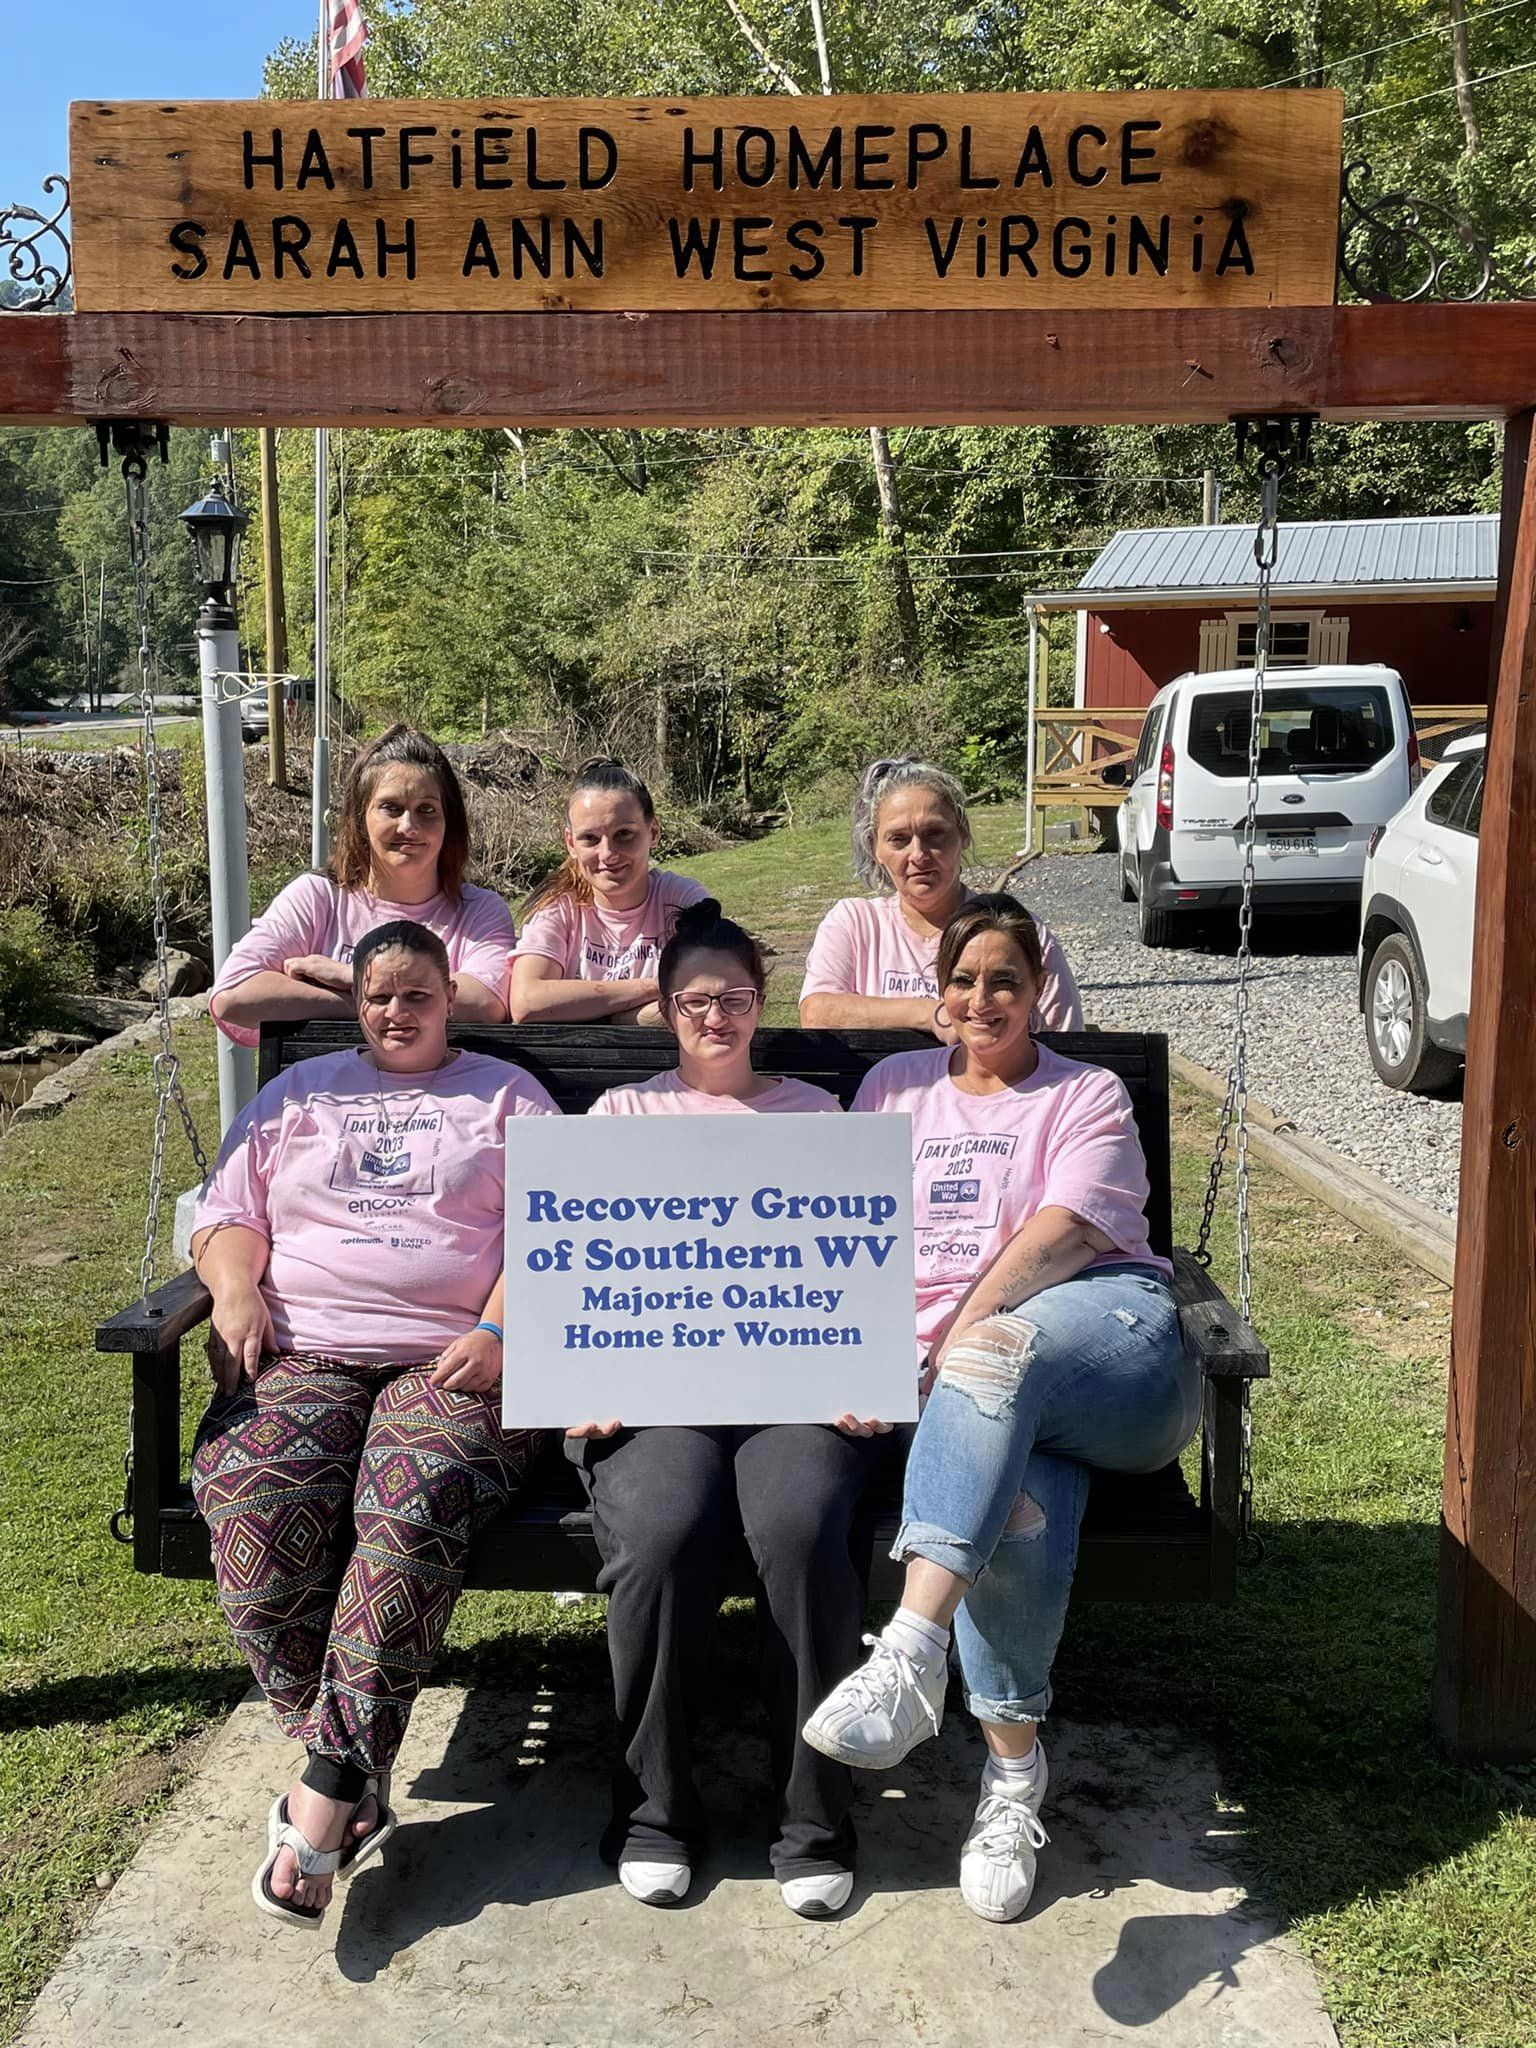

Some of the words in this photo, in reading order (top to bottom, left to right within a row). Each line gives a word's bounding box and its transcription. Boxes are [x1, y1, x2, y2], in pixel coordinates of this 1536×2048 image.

[683, 120, 1162, 191] HOMEPLACE
[169, 215, 416, 280] SARAH
[462, 216, 604, 279] ANN
[668, 217, 878, 281] WEST
[586, 945, 605, 966] DAY
[889, 977, 909, 992] DAY
[912, 977, 922, 992] OF
[351, 1118, 376, 1134] DAY
[394, 1117, 438, 1134] CARING
[924, 1144, 949, 1159] DAY
[950, 1141, 964, 1158] OF
[964, 1139, 1010, 1156] CARING
[944, 1158, 973, 1176] 2023
[932, 1182, 958, 1192] United
[941, 1191, 958, 1202] Way
[526, 1190, 739, 1227] Recovery
[751, 1187, 898, 1226] Group
[526, 1239, 574, 1272] of
[585, 1238, 803, 1271] Southern
[814, 1235, 898, 1268] WV
[581, 1285, 713, 1316] Majorie
[722, 1284, 844, 1313] Oakley
[564, 1323, 664, 1349] Home
[672, 1322, 726, 1348] for
[734, 1321, 862, 1347] Women
